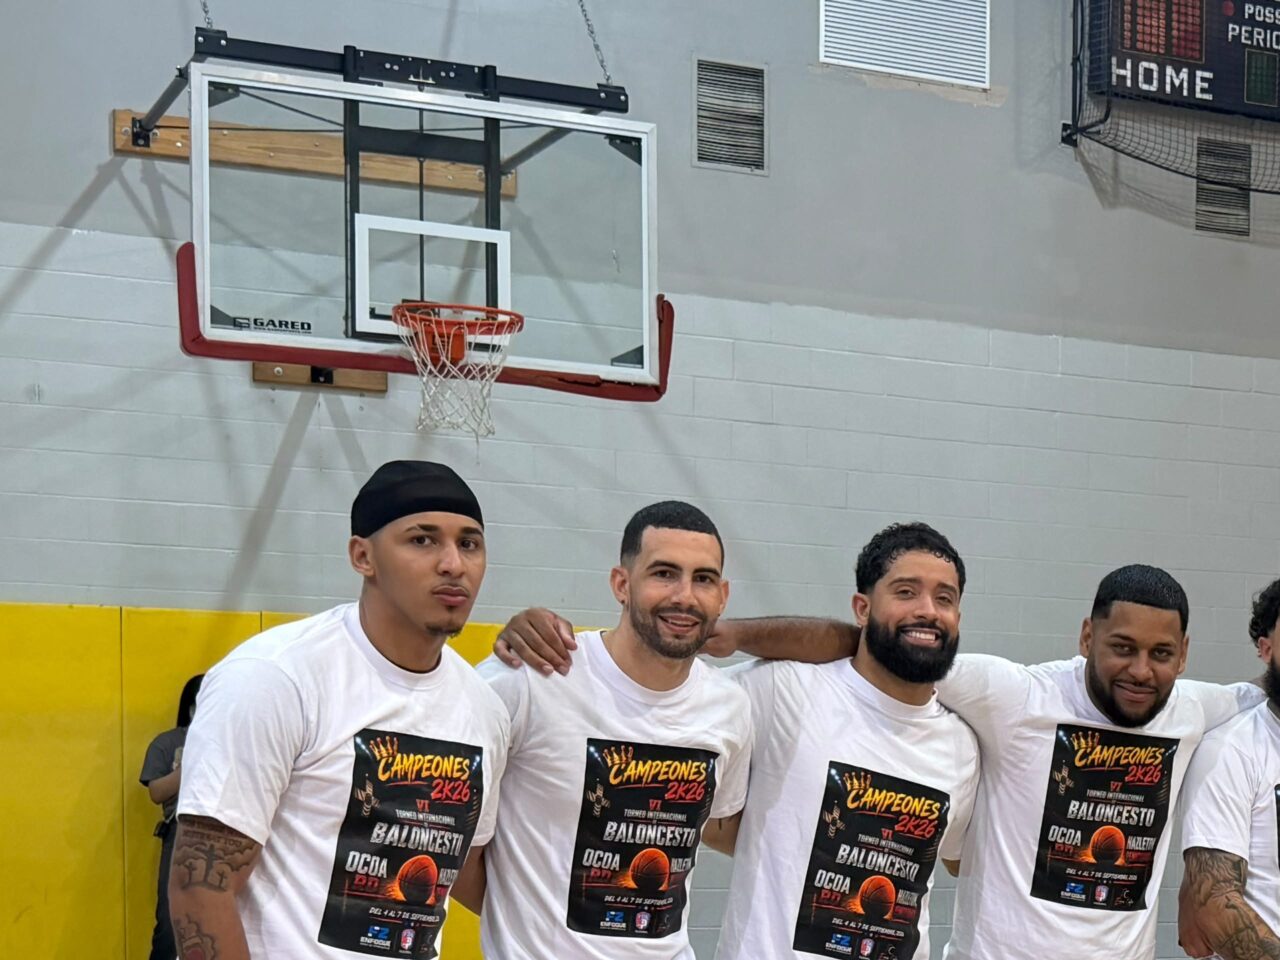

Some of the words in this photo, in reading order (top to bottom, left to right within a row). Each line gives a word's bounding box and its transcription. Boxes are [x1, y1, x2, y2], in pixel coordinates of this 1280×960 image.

[1111, 55, 1214, 101] HOME
[253, 317, 312, 331] GARED
[378, 752, 470, 782] CAMPEONES
[1074, 745, 1165, 771] CAMPEONES
[609, 759, 707, 787] CAMPEONES
[1124, 765, 1162, 783] 2K26
[430, 778, 472, 802] 2K26
[664, 781, 705, 801] 2K26
[846, 788, 941, 820] CAMPEONES
[1066, 799, 1156, 827] BALONCESTO
[370, 822, 465, 857] BALONCESTO
[603, 821, 697, 847] BALONCESTO
[894, 815, 938, 838] 2K26
[1048, 825, 1082, 847] OCOA
[345, 850, 388, 879] OCOA
[582, 848, 620, 871] OCOA
[836, 843, 920, 882] BALONCESTO
[814, 869, 851, 894] OCOA
